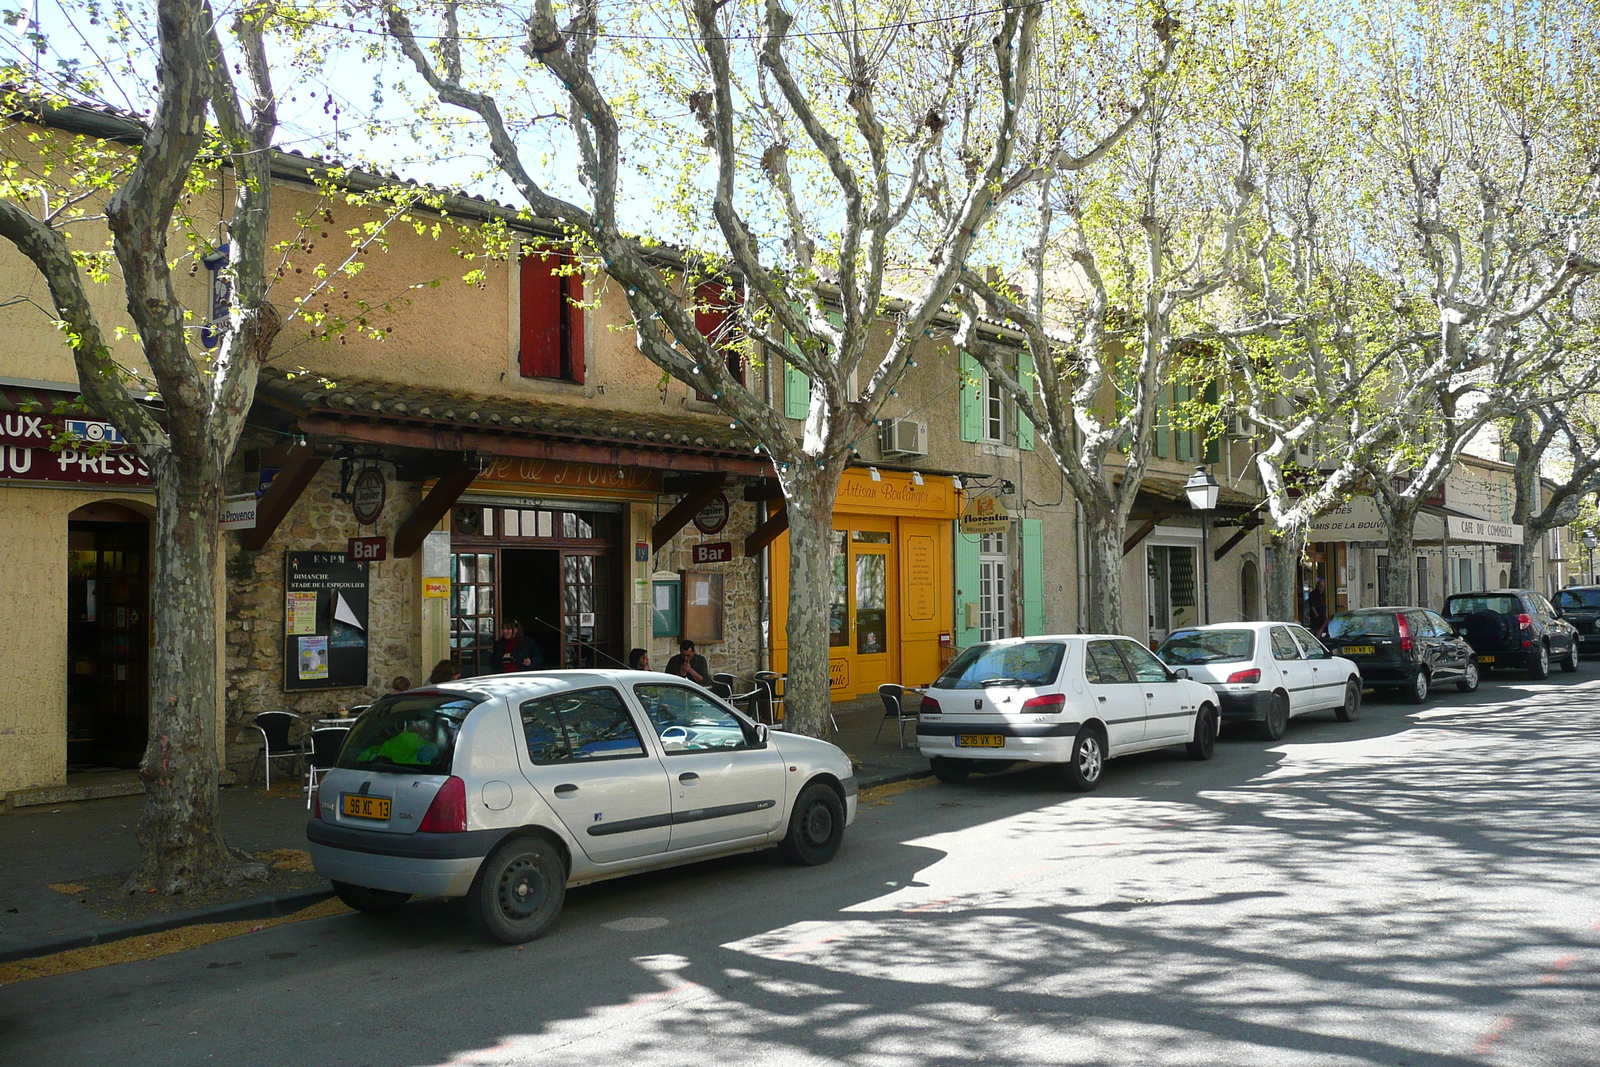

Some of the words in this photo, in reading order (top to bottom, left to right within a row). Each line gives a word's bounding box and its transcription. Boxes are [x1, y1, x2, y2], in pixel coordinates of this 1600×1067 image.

[57, 449, 149, 476] PRESS
[838, 480, 877, 499] Artisan
[881, 483, 929, 507] Boulanger
[226, 510, 255, 521] Provence
[1335, 507, 1352, 515] DES
[964, 513, 1009, 523] florentin
[1331, 522, 1343, 530] DE
[1344, 521, 1356, 529] LA
[1461, 521, 1473, 533] CAFE
[1477, 522, 1484, 534] DU
[1487, 524, 1513, 537] COMMERCE
[354, 541, 380, 558] Bar
[698, 547, 725, 561] Bar
[313, 555, 345, 564] ESPM
[980, 736, 990, 745] VX
[994, 737, 1002, 746] 13
[350, 798, 360, 814] 96
[362, 799, 373, 815] XC
[378, 801, 389, 818] 13
